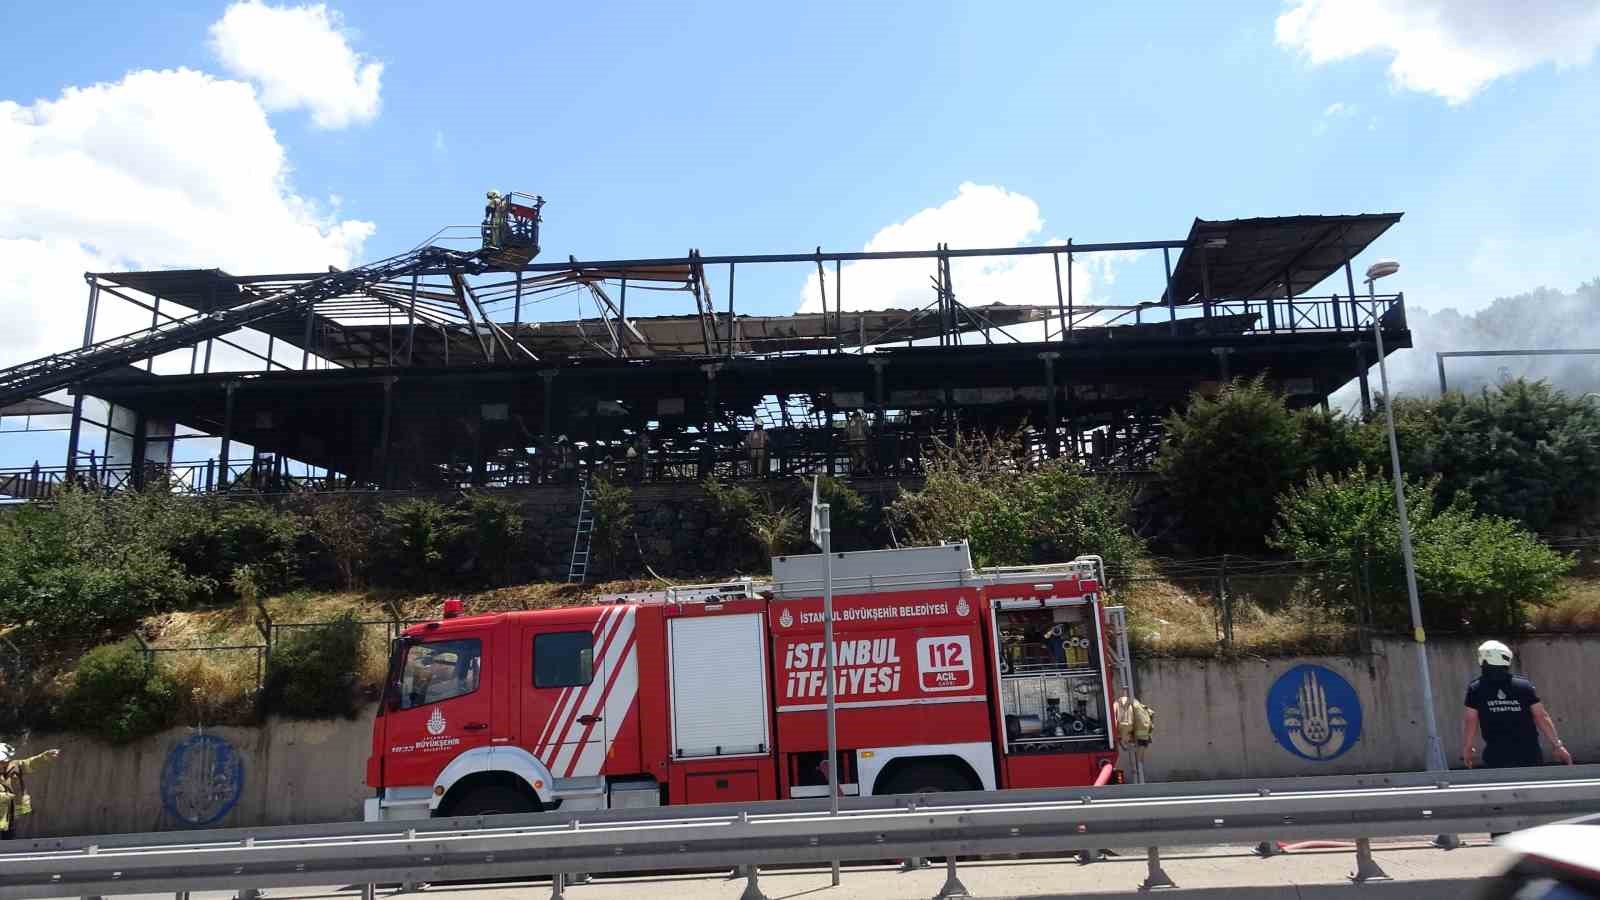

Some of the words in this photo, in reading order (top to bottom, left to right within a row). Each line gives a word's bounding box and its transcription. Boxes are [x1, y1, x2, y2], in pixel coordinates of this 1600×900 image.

[800, 611, 842, 624] İSTANUL
[843, 605, 898, 621] BÜYÜKŞEHİR
[900, 600, 949, 617] BELEDİYESİ
[929, 642, 964, 668] 112
